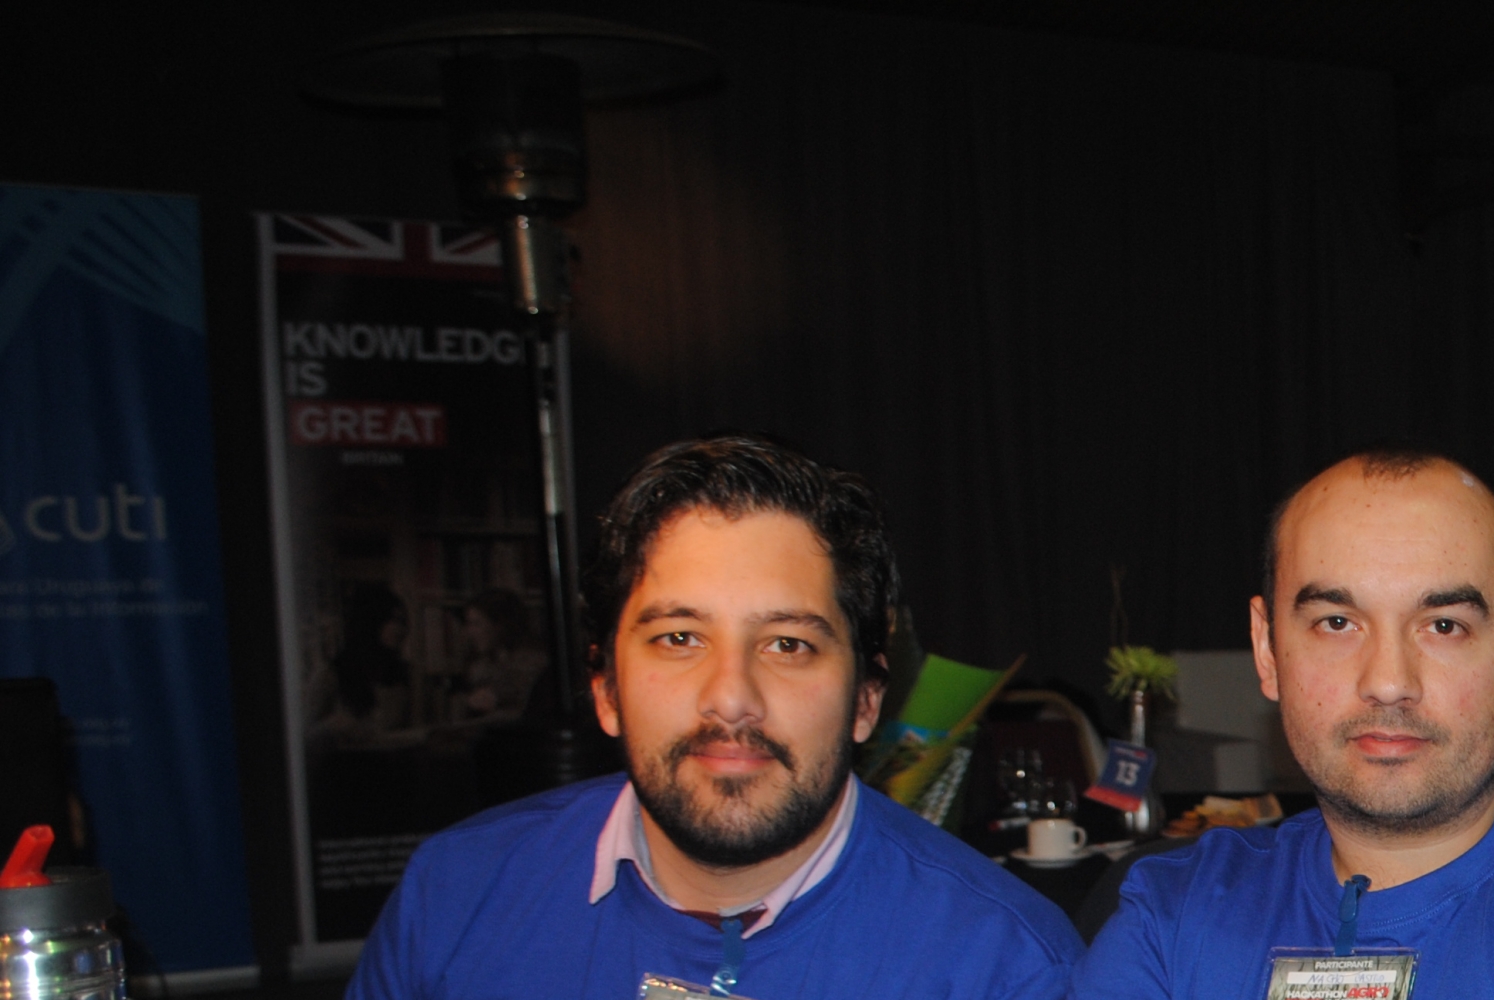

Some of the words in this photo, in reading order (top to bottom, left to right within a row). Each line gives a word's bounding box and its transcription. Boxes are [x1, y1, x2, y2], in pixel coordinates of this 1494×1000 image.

[283, 321, 526, 366] KNOWLEDG
[286, 360, 328, 397] IS
[297, 406, 443, 443] GREAT
[24, 482, 167, 542] cuti
[1116, 760, 1141, 787] 13
[1314, 960, 1374, 970] PARTICIPANTE
